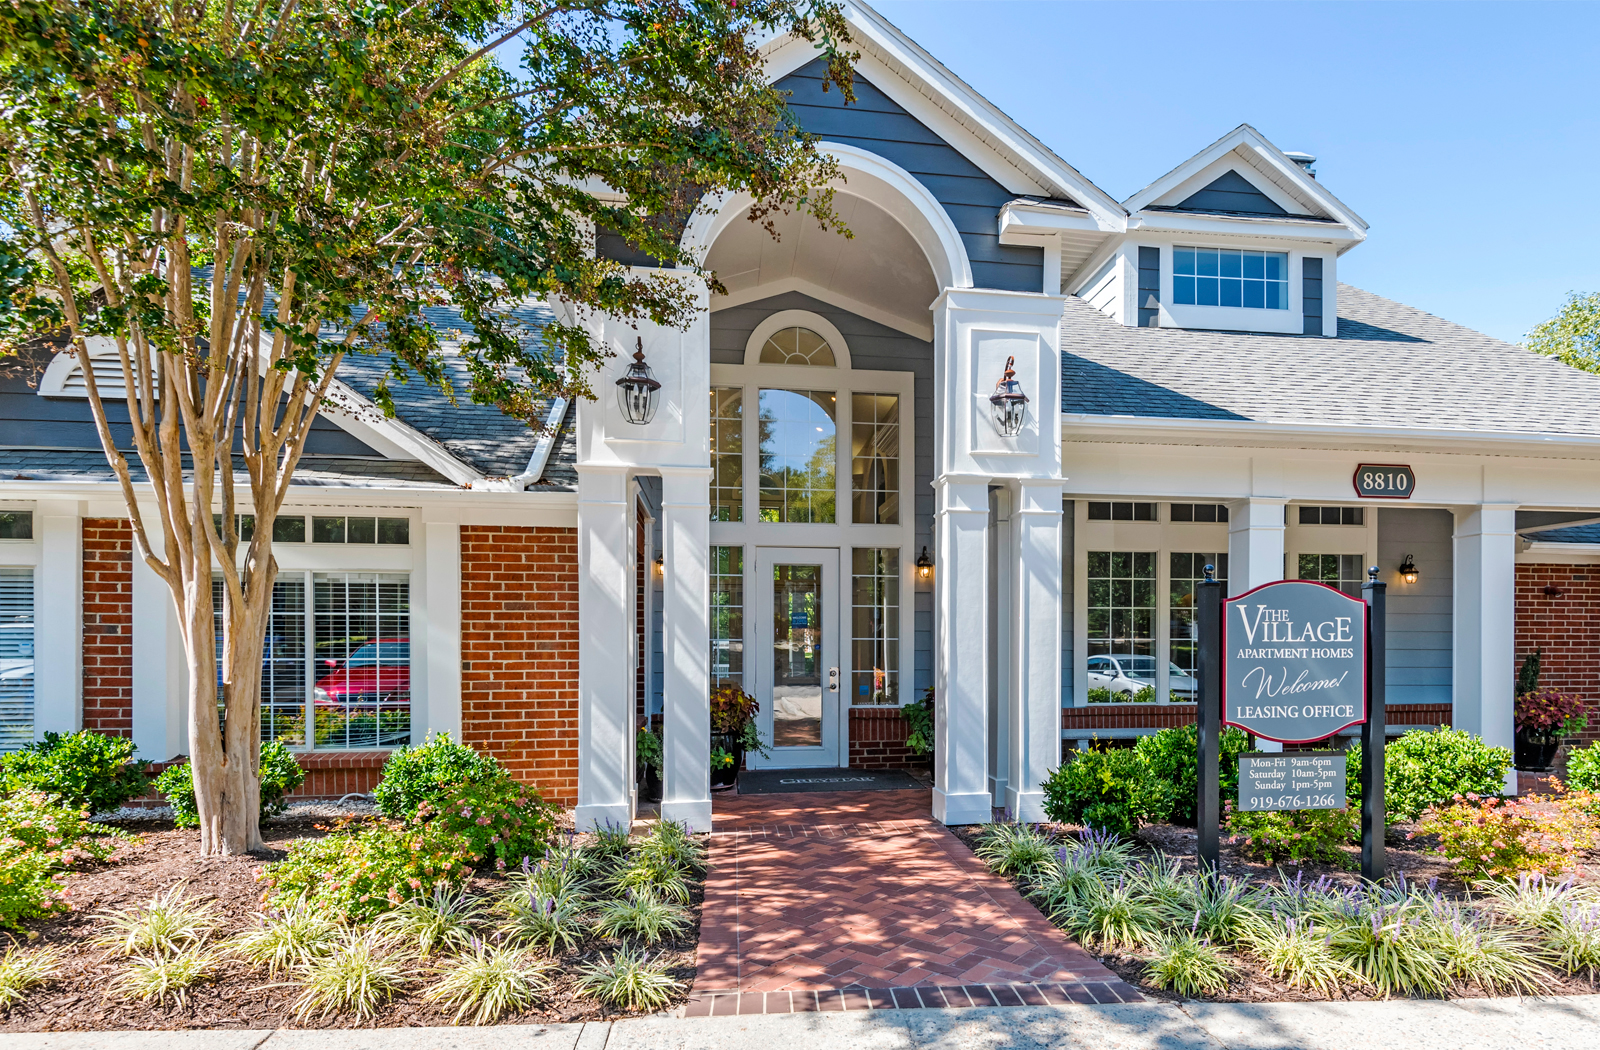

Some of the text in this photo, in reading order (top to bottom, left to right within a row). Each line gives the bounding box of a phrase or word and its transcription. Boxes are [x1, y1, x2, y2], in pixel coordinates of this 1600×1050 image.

[1363, 472, 1407, 491] 8810
[1262, 609, 1289, 622] THE
[1236, 604, 1353, 645] VILLAGE
[1237, 648, 1354, 659] APARTMENT HOMES
[1241, 666, 1349, 700] Welcome!
[1237, 704, 1354, 719] LEASING OFFICE
[1250, 757, 1332, 769] Mon-Fri 9am-6pm
[1249, 768, 1337, 780] Saturday 10am-5pm
[1254, 780, 1332, 791] Sunday 1pm-5pm
[1250, 794, 1335, 809] 919-676-1266
